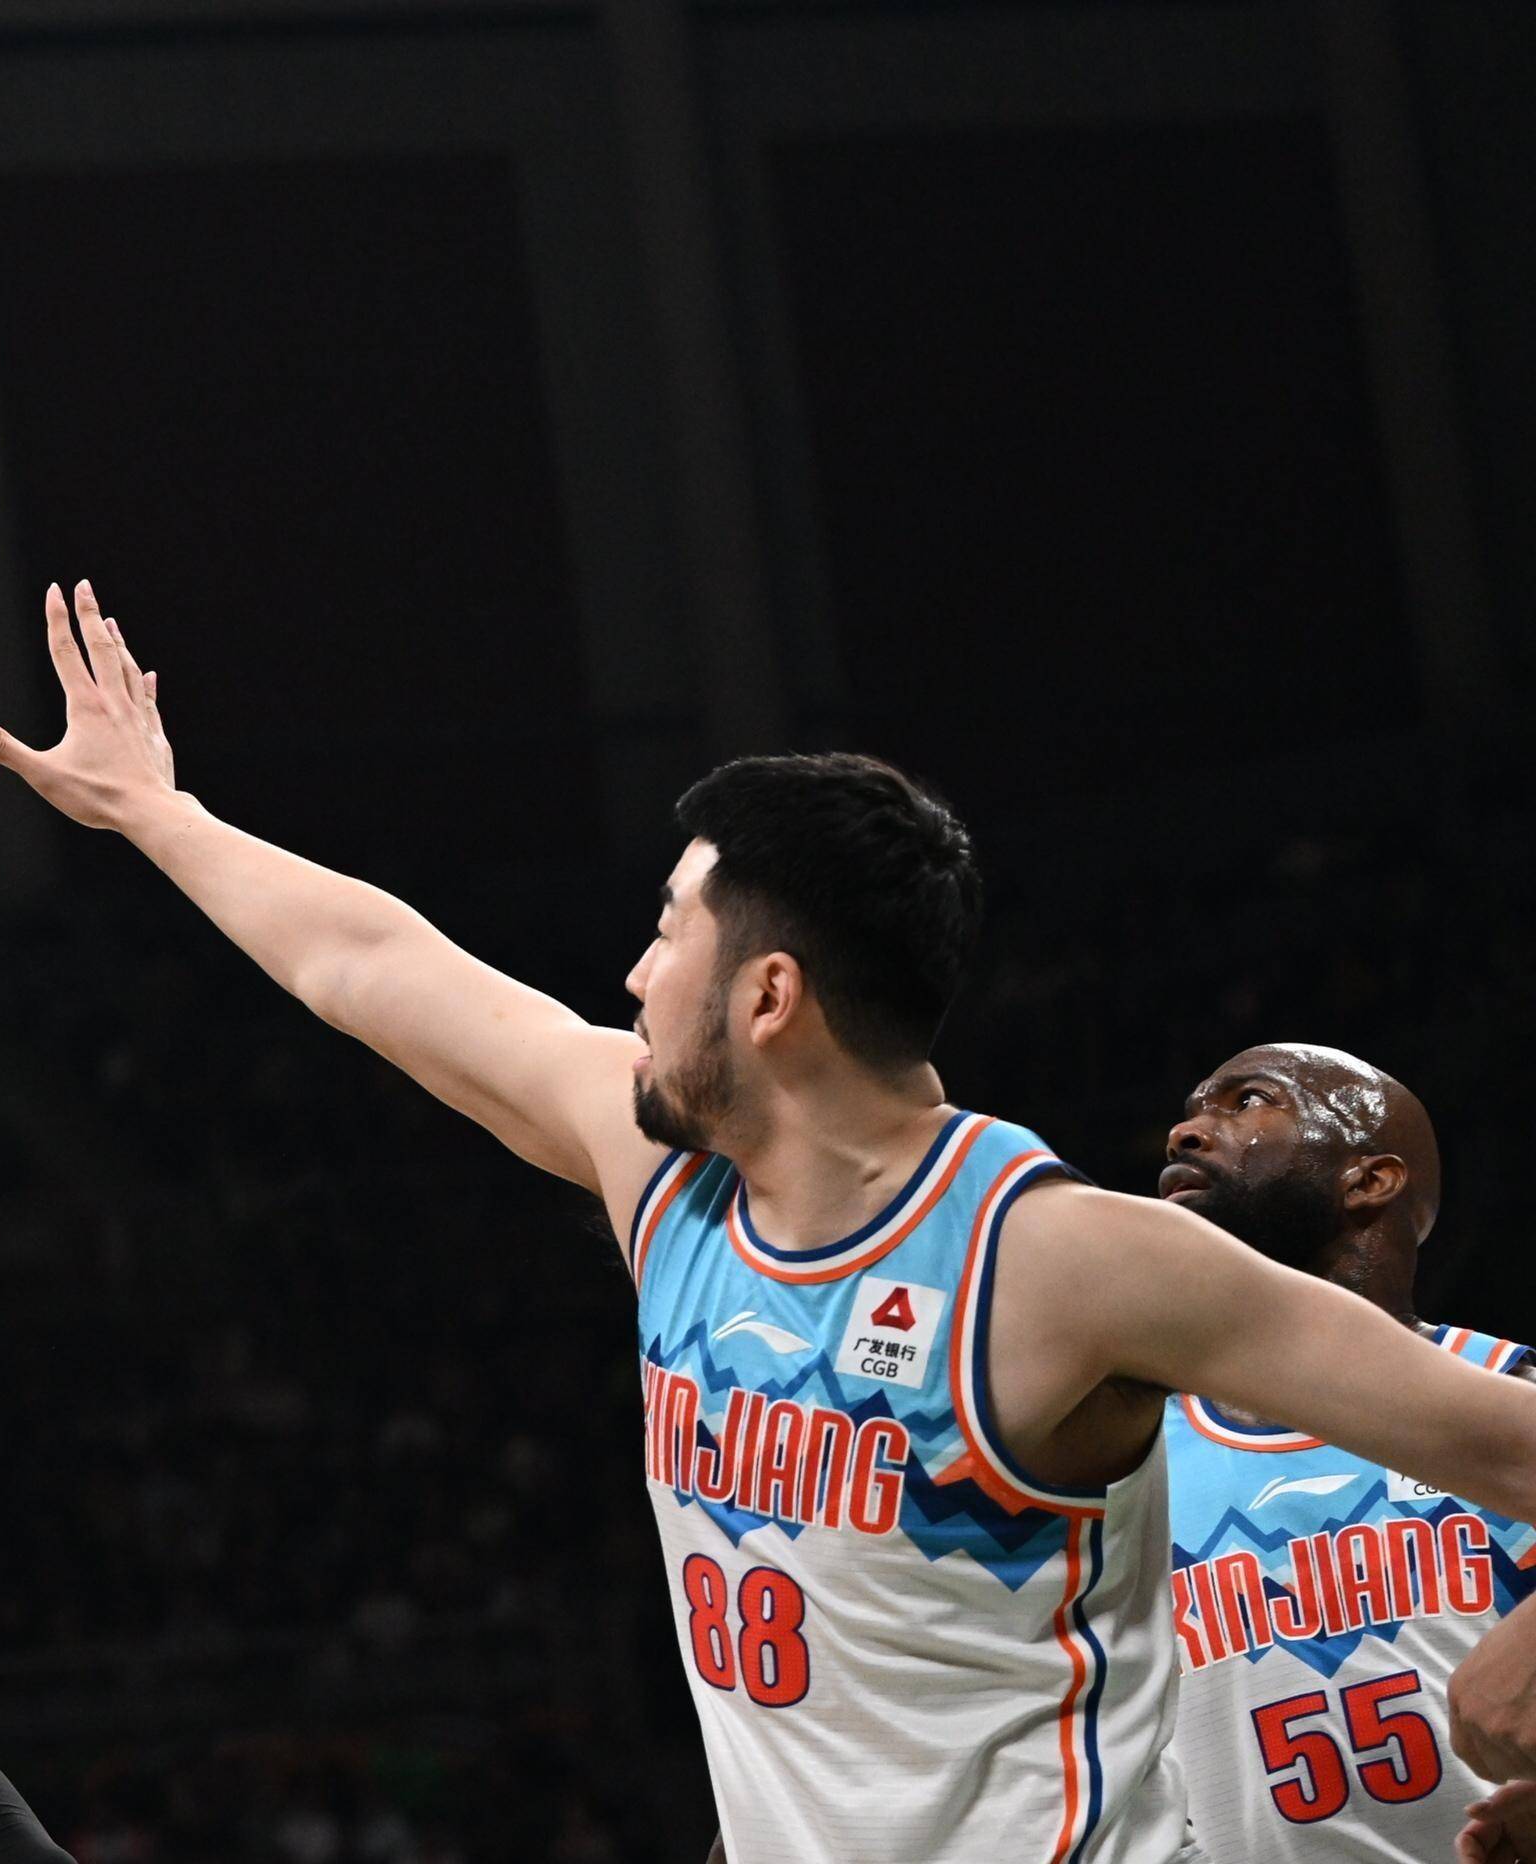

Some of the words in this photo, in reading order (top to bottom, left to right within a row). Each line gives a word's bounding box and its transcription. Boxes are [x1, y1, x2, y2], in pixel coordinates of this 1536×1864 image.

[853, 1337, 917, 1361] 广发银行
[861, 1358, 898, 1378] CGB
[682, 1552, 811, 1709] 88
[1250, 1668, 1444, 1825] 55
